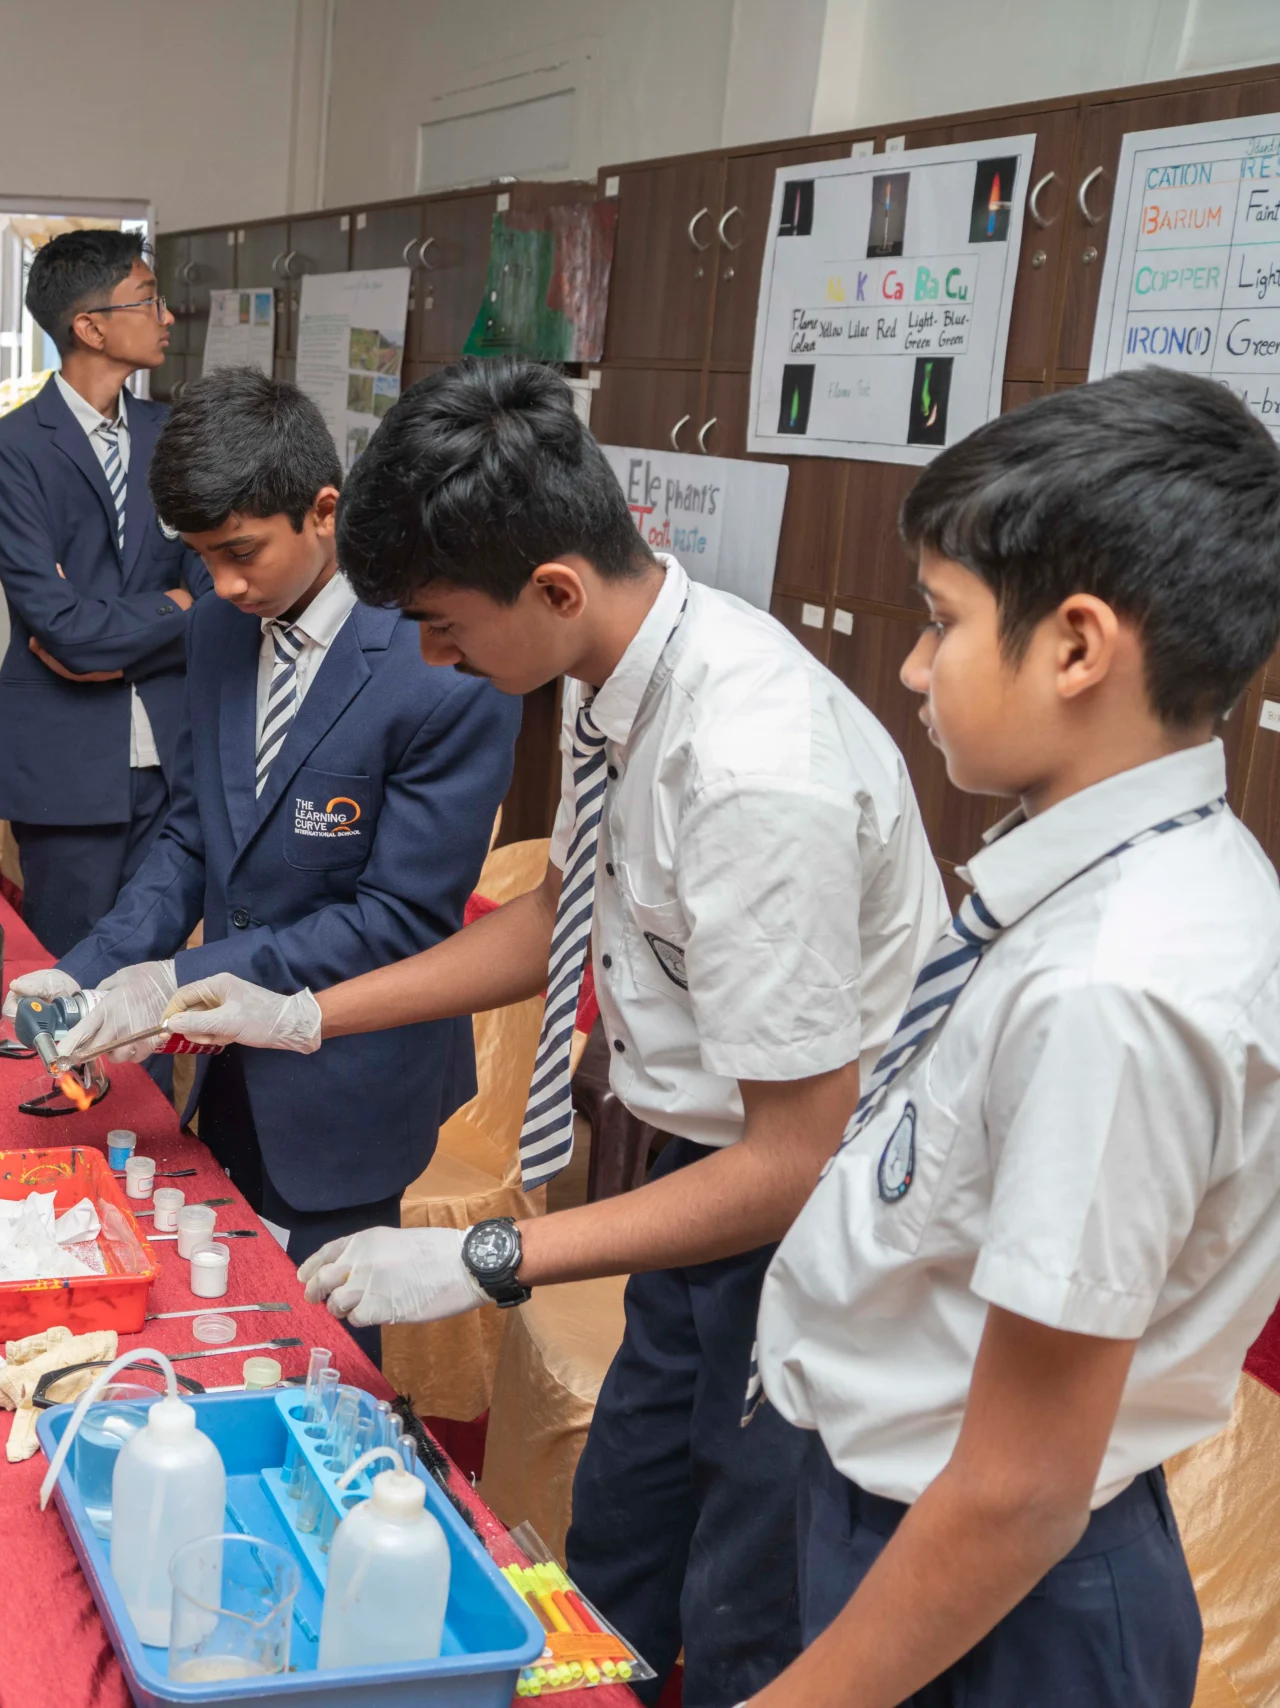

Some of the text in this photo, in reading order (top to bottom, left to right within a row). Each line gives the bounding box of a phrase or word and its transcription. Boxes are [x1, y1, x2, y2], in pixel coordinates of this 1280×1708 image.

[1147, 163, 1213, 190] CATION
[1142, 189, 1280, 235] BARIUM Faint
[856, 271, 868, 302] K
[882, 270, 904, 300] Ca
[914, 266, 940, 302] Ba
[945, 267, 968, 301] Cu
[1135, 266, 1221, 296] COPPER
[792, 308, 819, 330] Flame
[819, 317, 898, 340] Yellow Lilac Red
[904, 332, 931, 350] Green
[938, 330, 964, 347] Green
[295, 798, 314, 811] THE
[295, 808, 347, 823] LEARNING
[294, 827, 361, 838] INTERNATIONAL SCHOOL
[295, 818, 328, 831] CURVE
